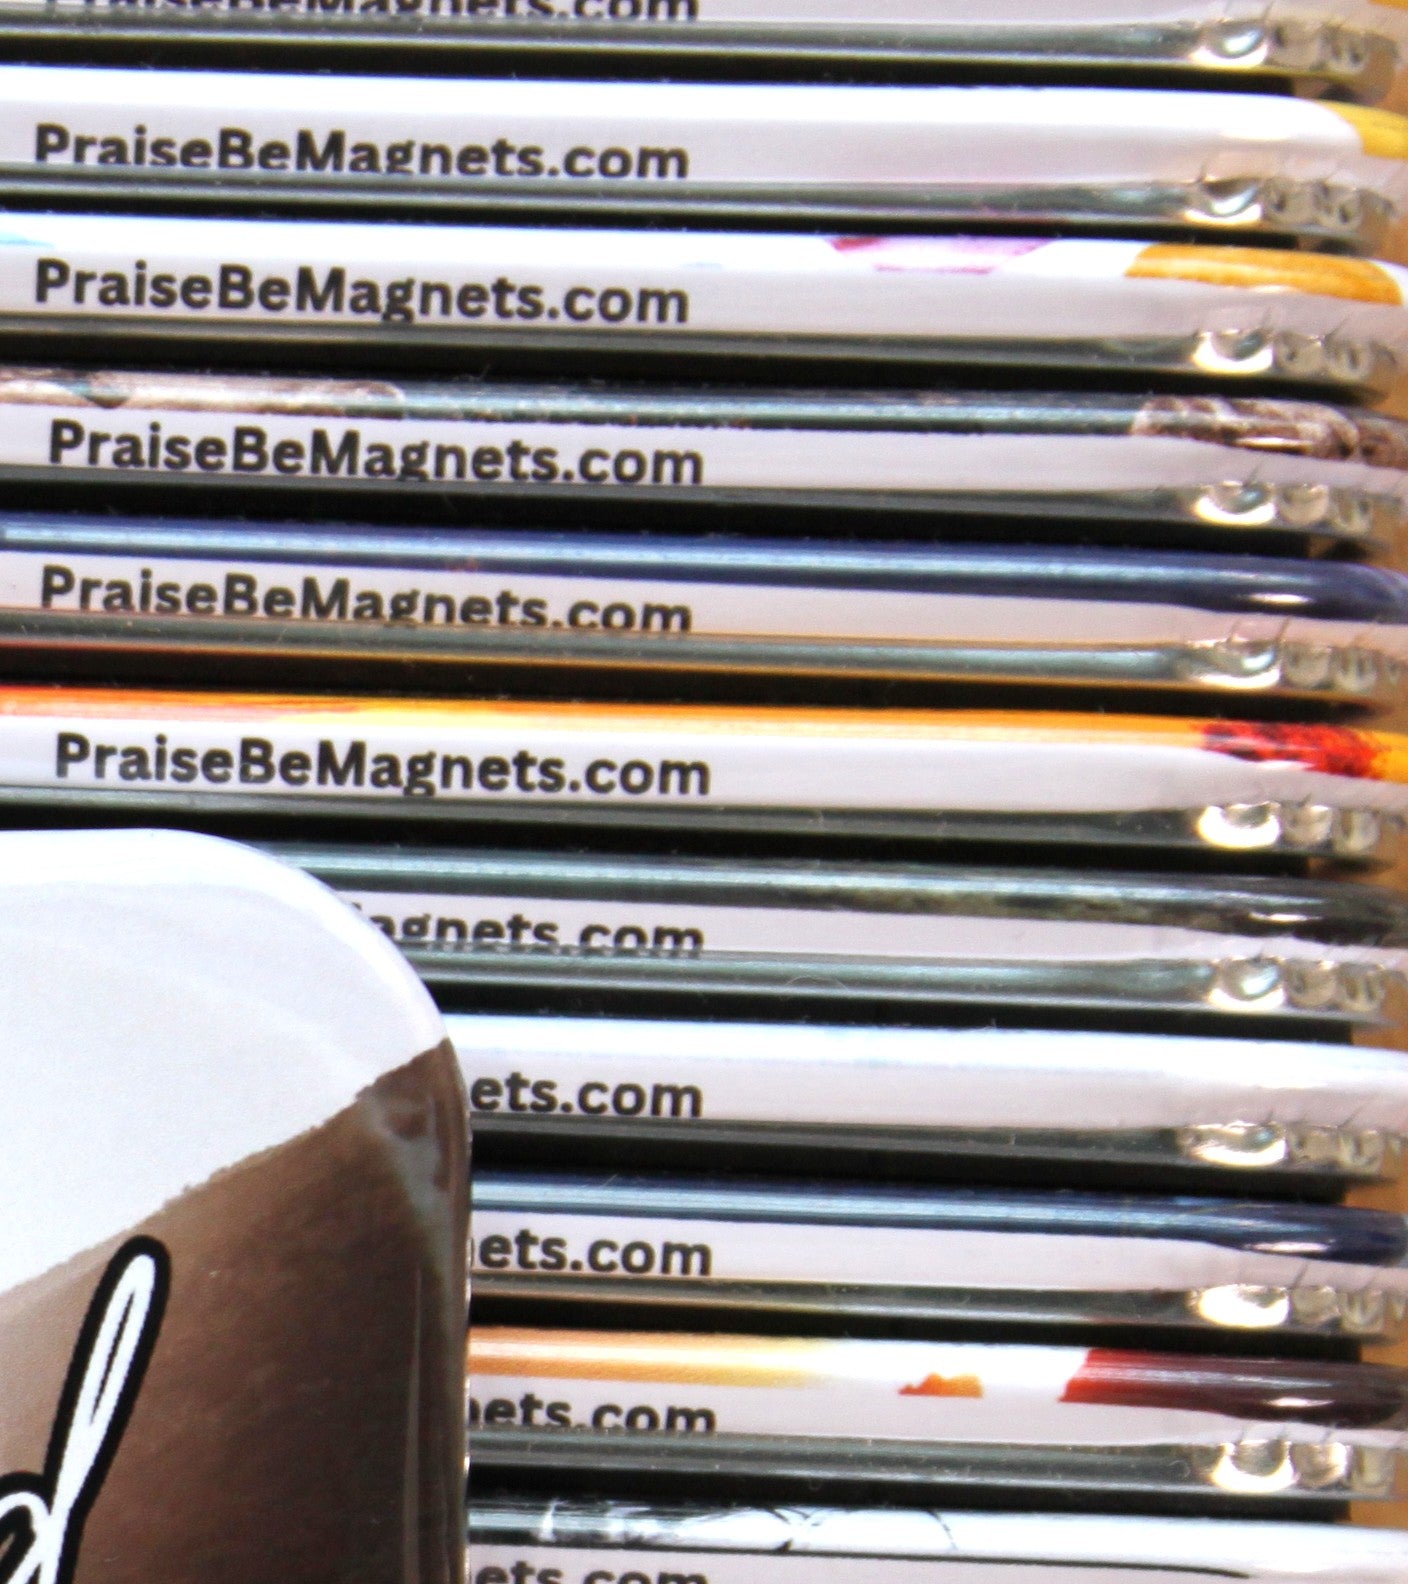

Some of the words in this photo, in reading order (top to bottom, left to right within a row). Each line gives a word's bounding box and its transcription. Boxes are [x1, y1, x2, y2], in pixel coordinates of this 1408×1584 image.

[36, 123, 689, 180] PraiseBeMagnets.com
[35, 259, 688, 323] PraiseBeMagnets.com
[49, 418, 703, 485] PraiseBeMagnets.com
[40, 564, 693, 633] PraiseBeMagnets.com
[55, 731, 711, 796] PraiseBeMagnets.com
[470, 1228, 712, 1276] ets.com
